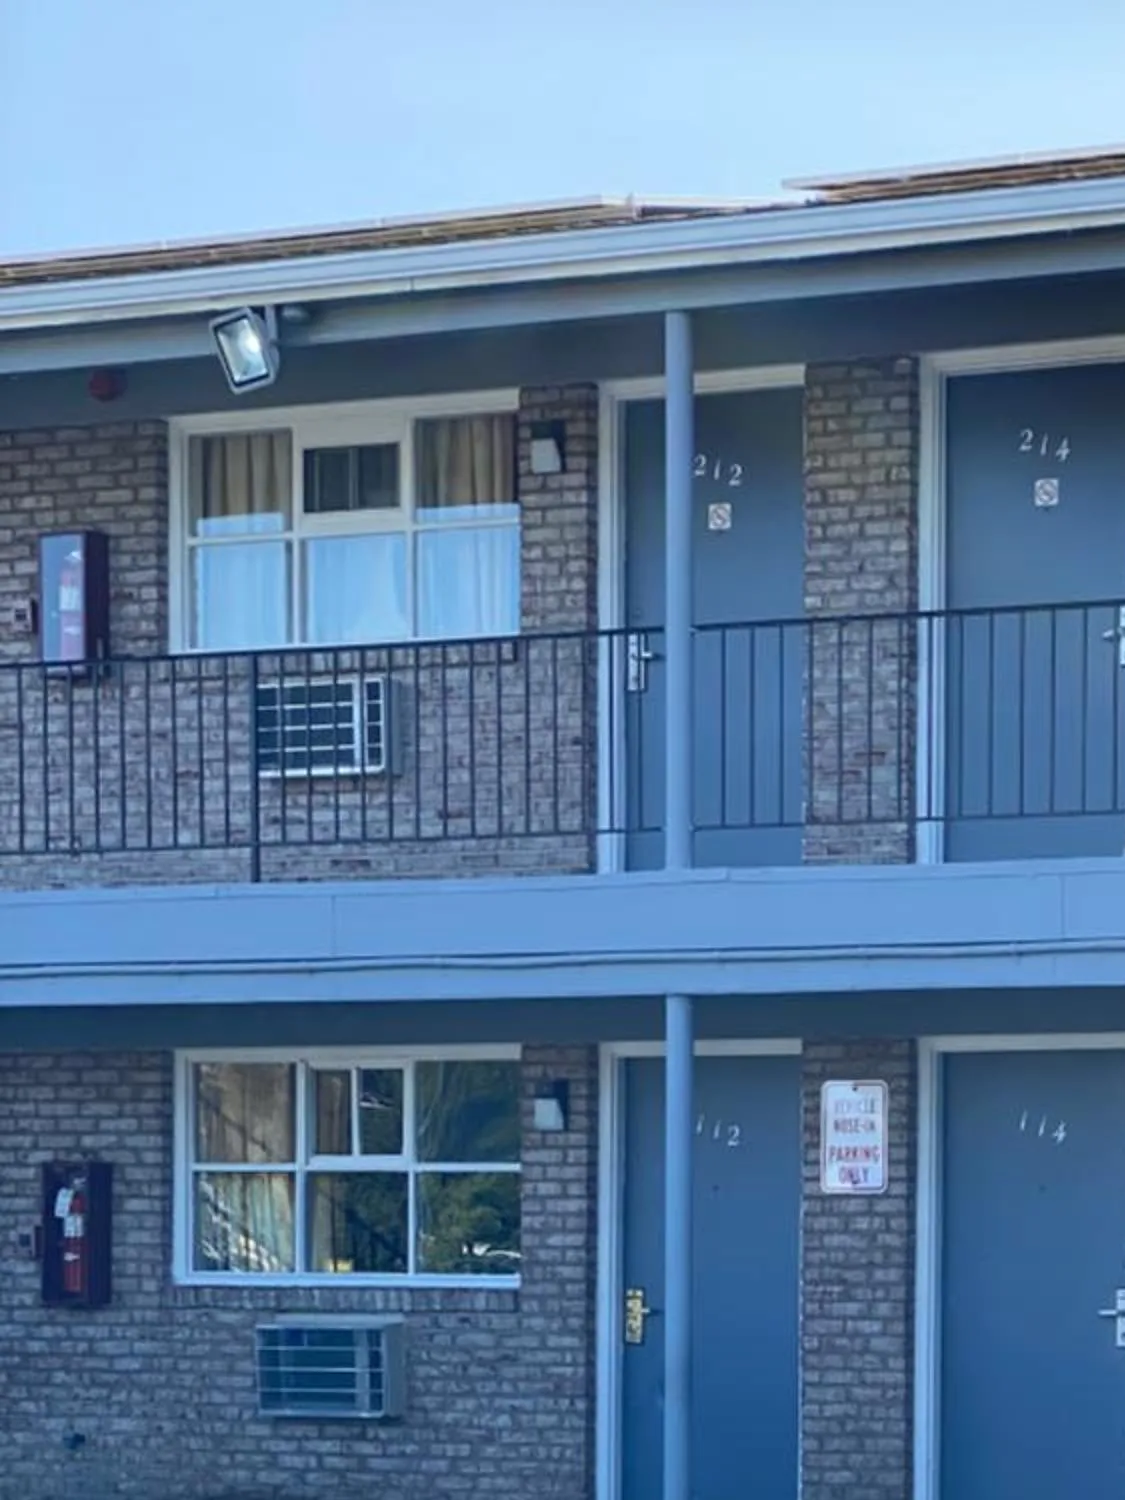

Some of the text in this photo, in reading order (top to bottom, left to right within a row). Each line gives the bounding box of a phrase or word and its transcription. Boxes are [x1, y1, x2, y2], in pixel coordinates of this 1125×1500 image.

[1019, 428, 1071, 461] 214
[692, 454, 742, 486] 212
[696, 1112, 740, 1147] 112
[1020, 1109, 1066, 1144] 114
[829, 1145, 880, 1162] PARKING
[838, 1165, 870, 1184] ONLY
